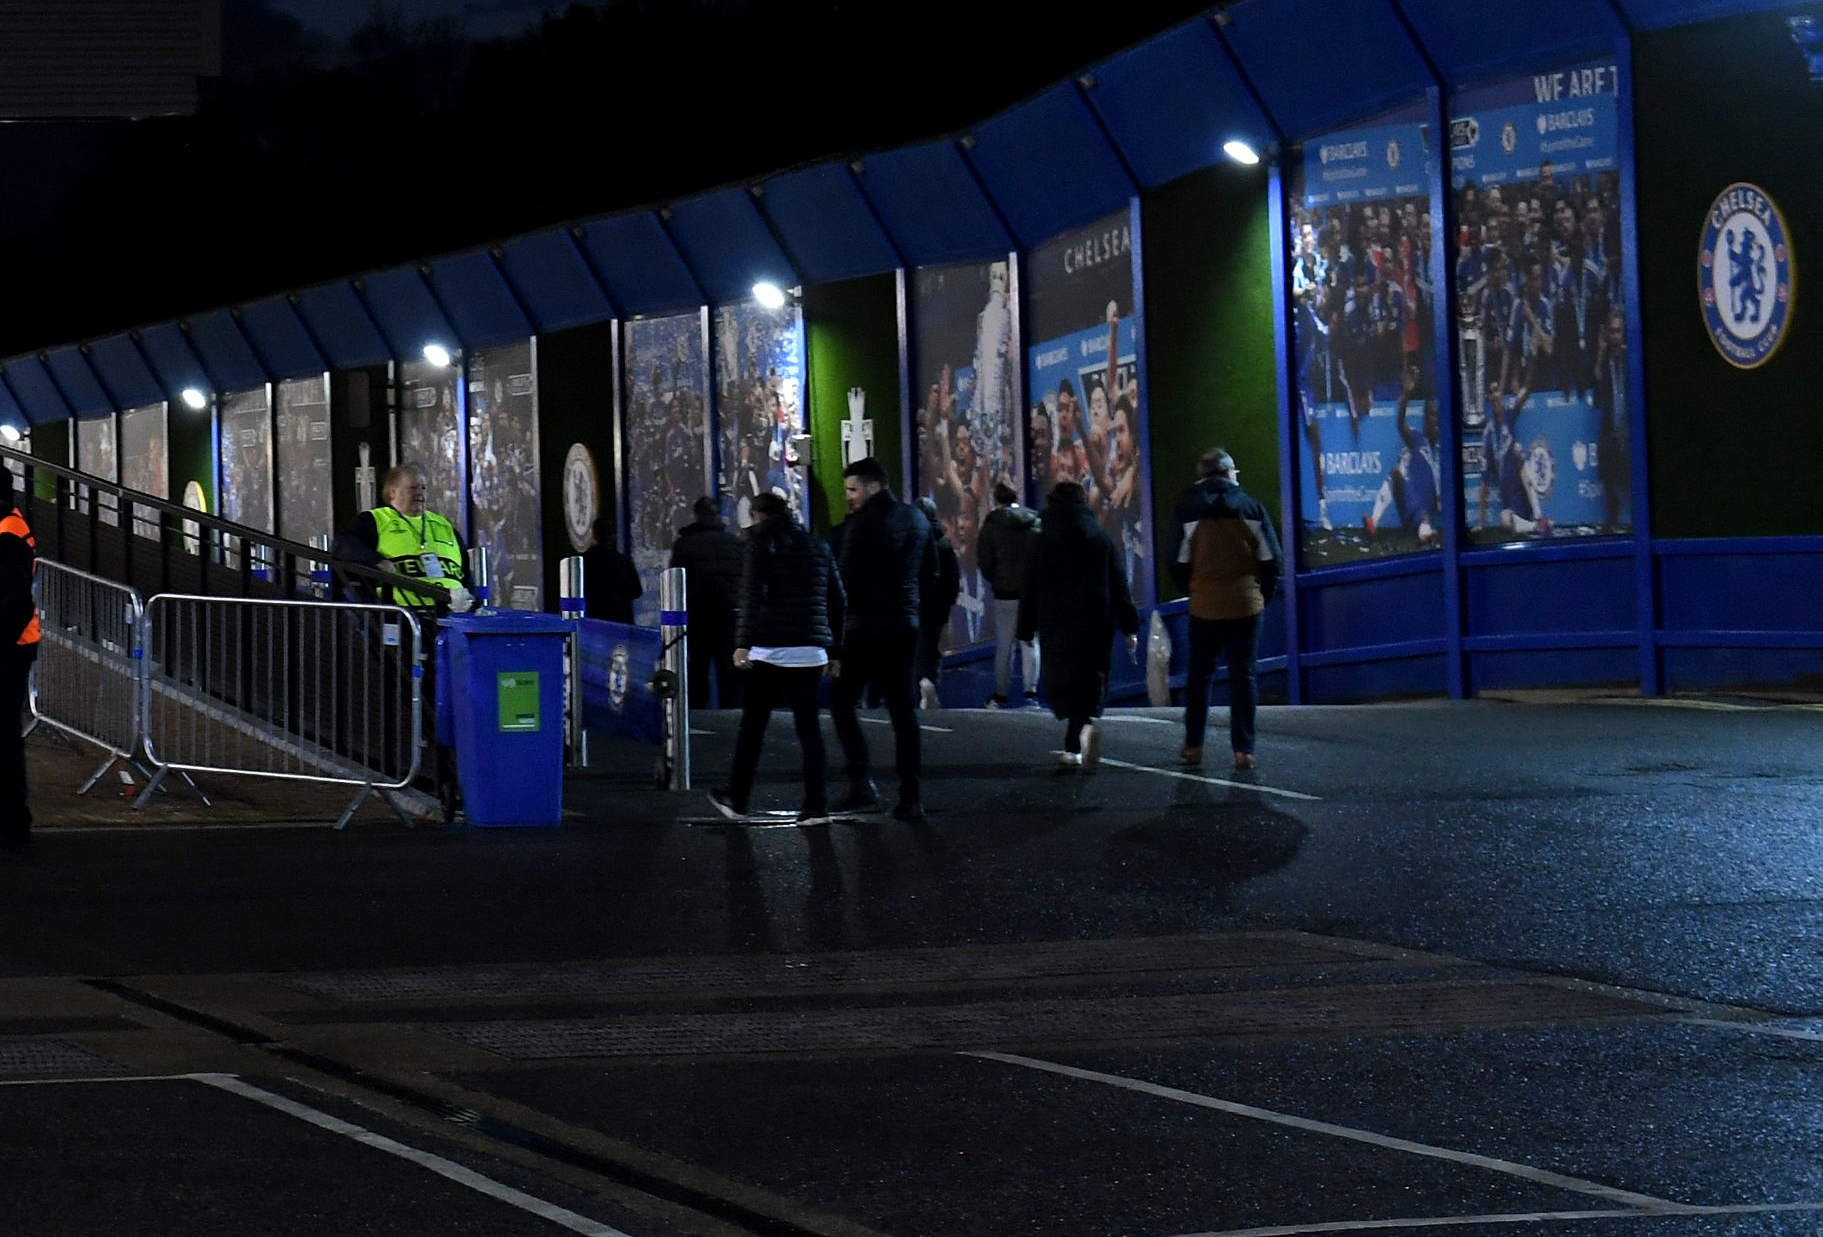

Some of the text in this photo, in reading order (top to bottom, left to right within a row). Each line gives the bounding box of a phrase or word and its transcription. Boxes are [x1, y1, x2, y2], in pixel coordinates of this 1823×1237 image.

[1547, 108, 1595, 132] BARCLAYS
[1711, 189, 1772, 230] CHELSEA
[1063, 226, 1131, 274] CHELSEA
[1326, 451, 1382, 475] BARCLAYS
